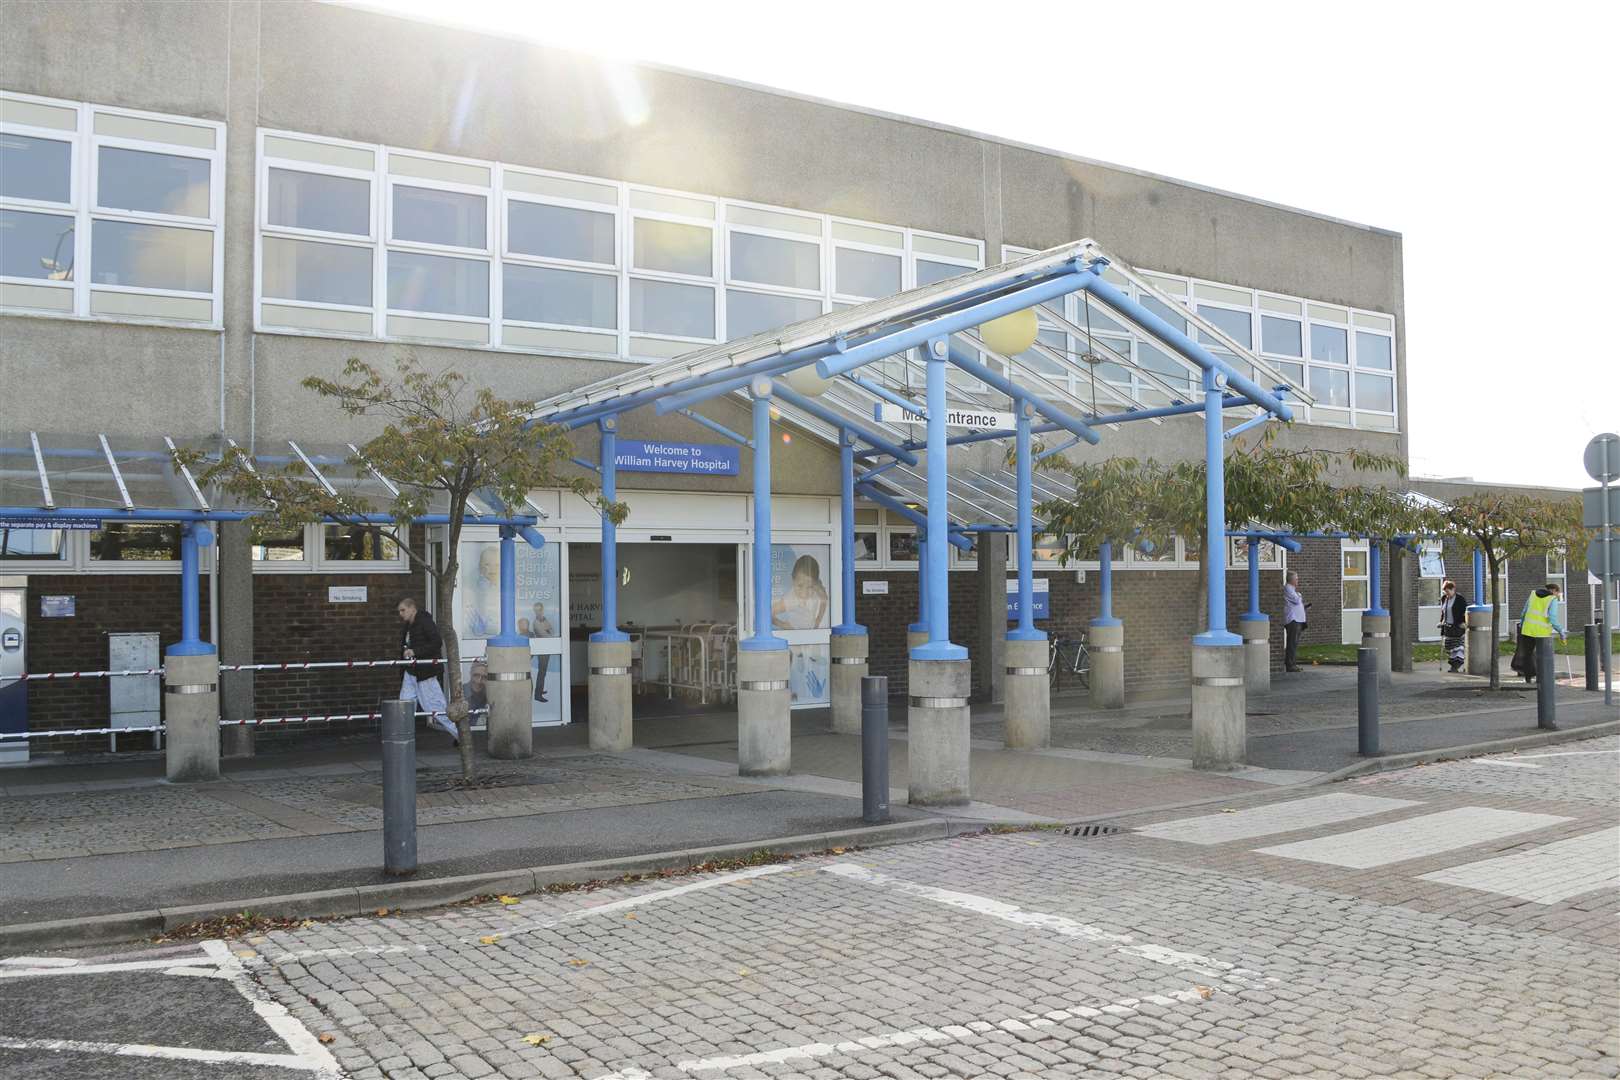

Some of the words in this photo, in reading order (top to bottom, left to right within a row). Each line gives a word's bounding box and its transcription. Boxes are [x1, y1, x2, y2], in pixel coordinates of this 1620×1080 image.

[948, 412, 996, 426] ntrance
[643, 444, 689, 456] Welcome
[691, 447, 702, 457] to
[614, 455, 652, 467] William
[654, 457, 689, 470] Harvey
[691, 459, 730, 471] Hospital
[517, 589, 552, 601] Lives
